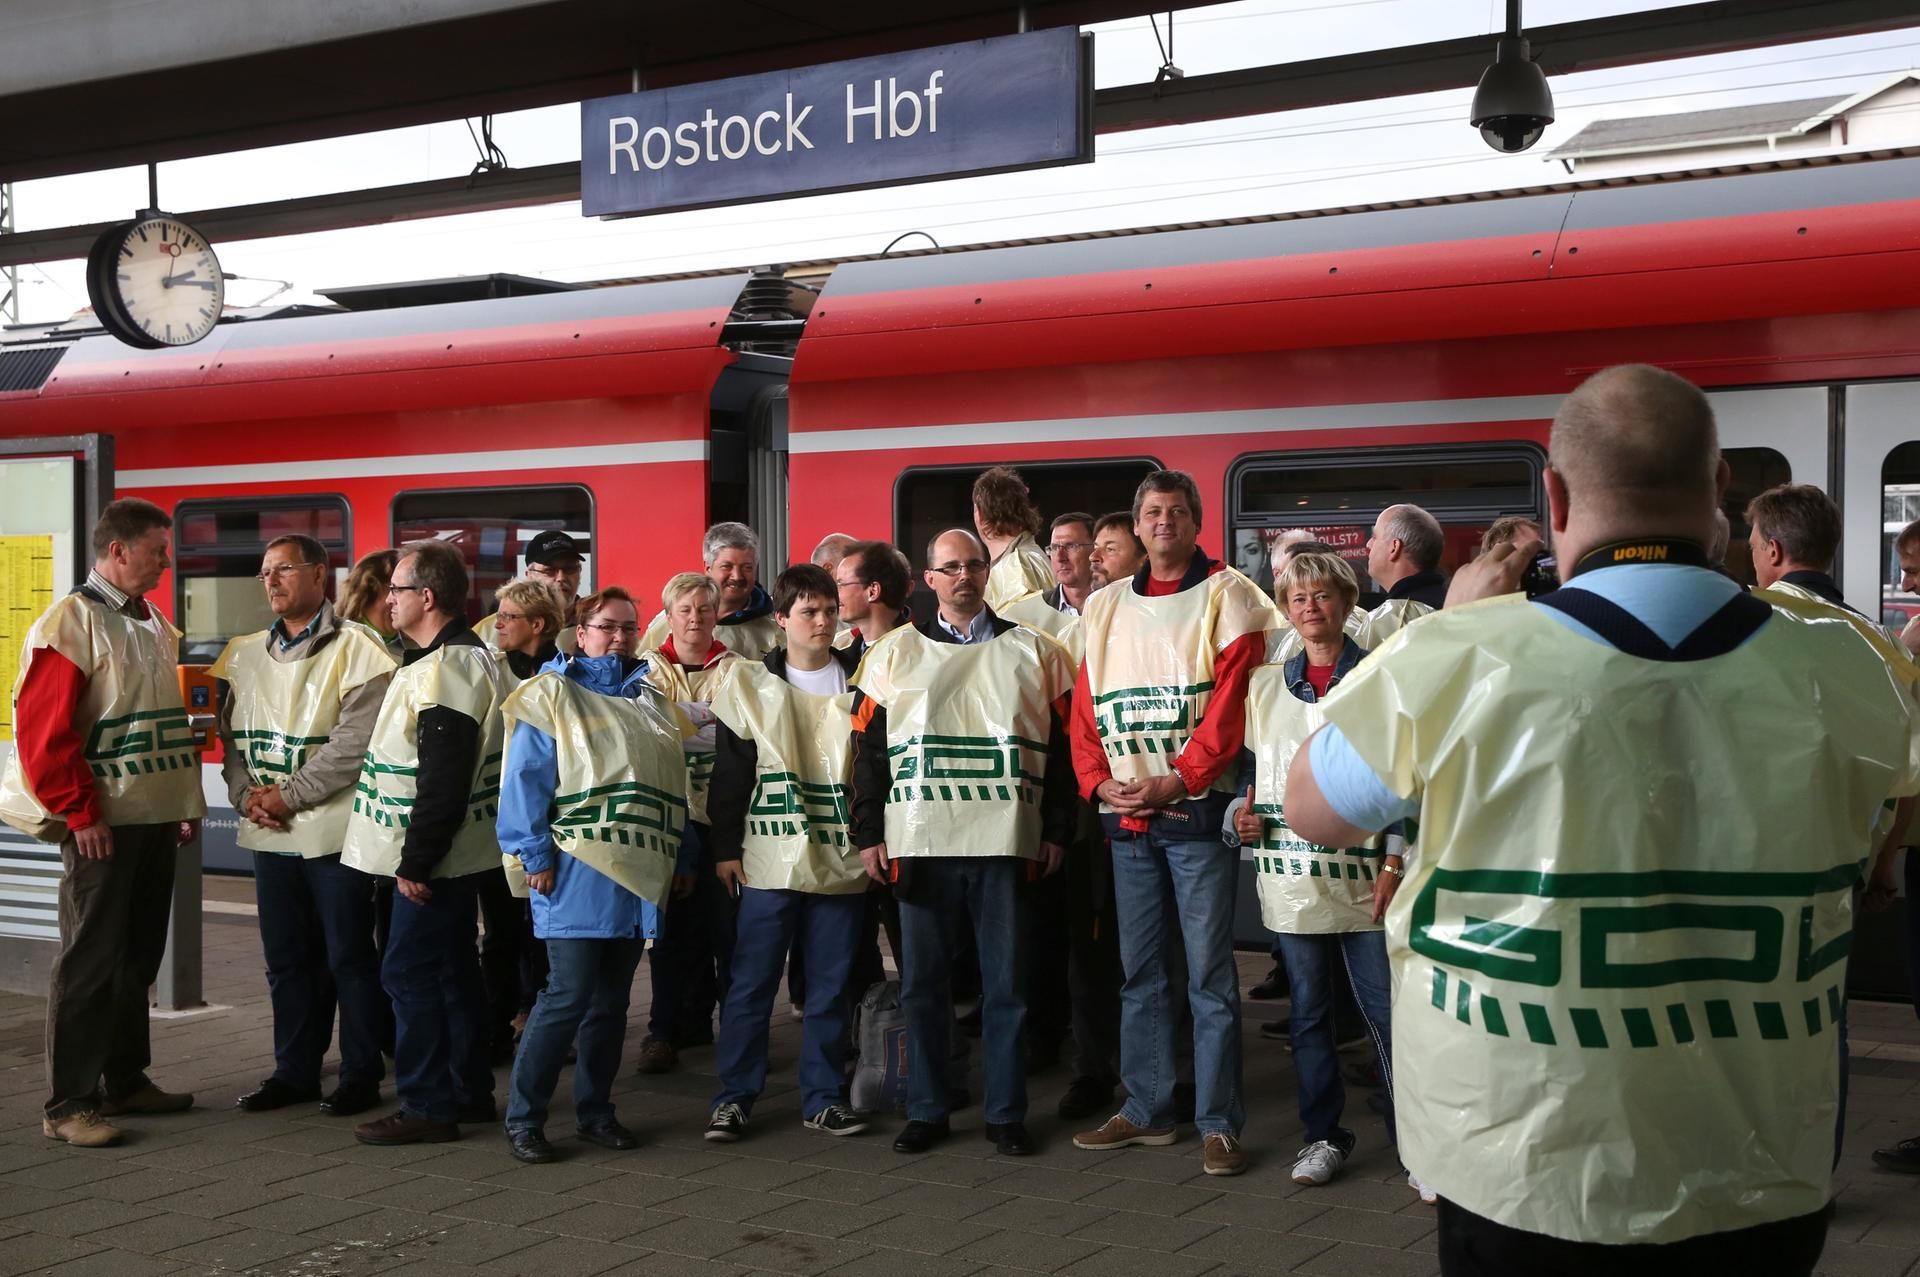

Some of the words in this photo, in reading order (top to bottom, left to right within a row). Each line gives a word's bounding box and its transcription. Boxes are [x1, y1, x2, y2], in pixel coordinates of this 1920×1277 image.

[608, 92, 816, 175] Rostock
[846, 70, 944, 144] Hbf
[1313, 532, 1359, 546] OLLST?
[1613, 545, 1668, 560] Nikon
